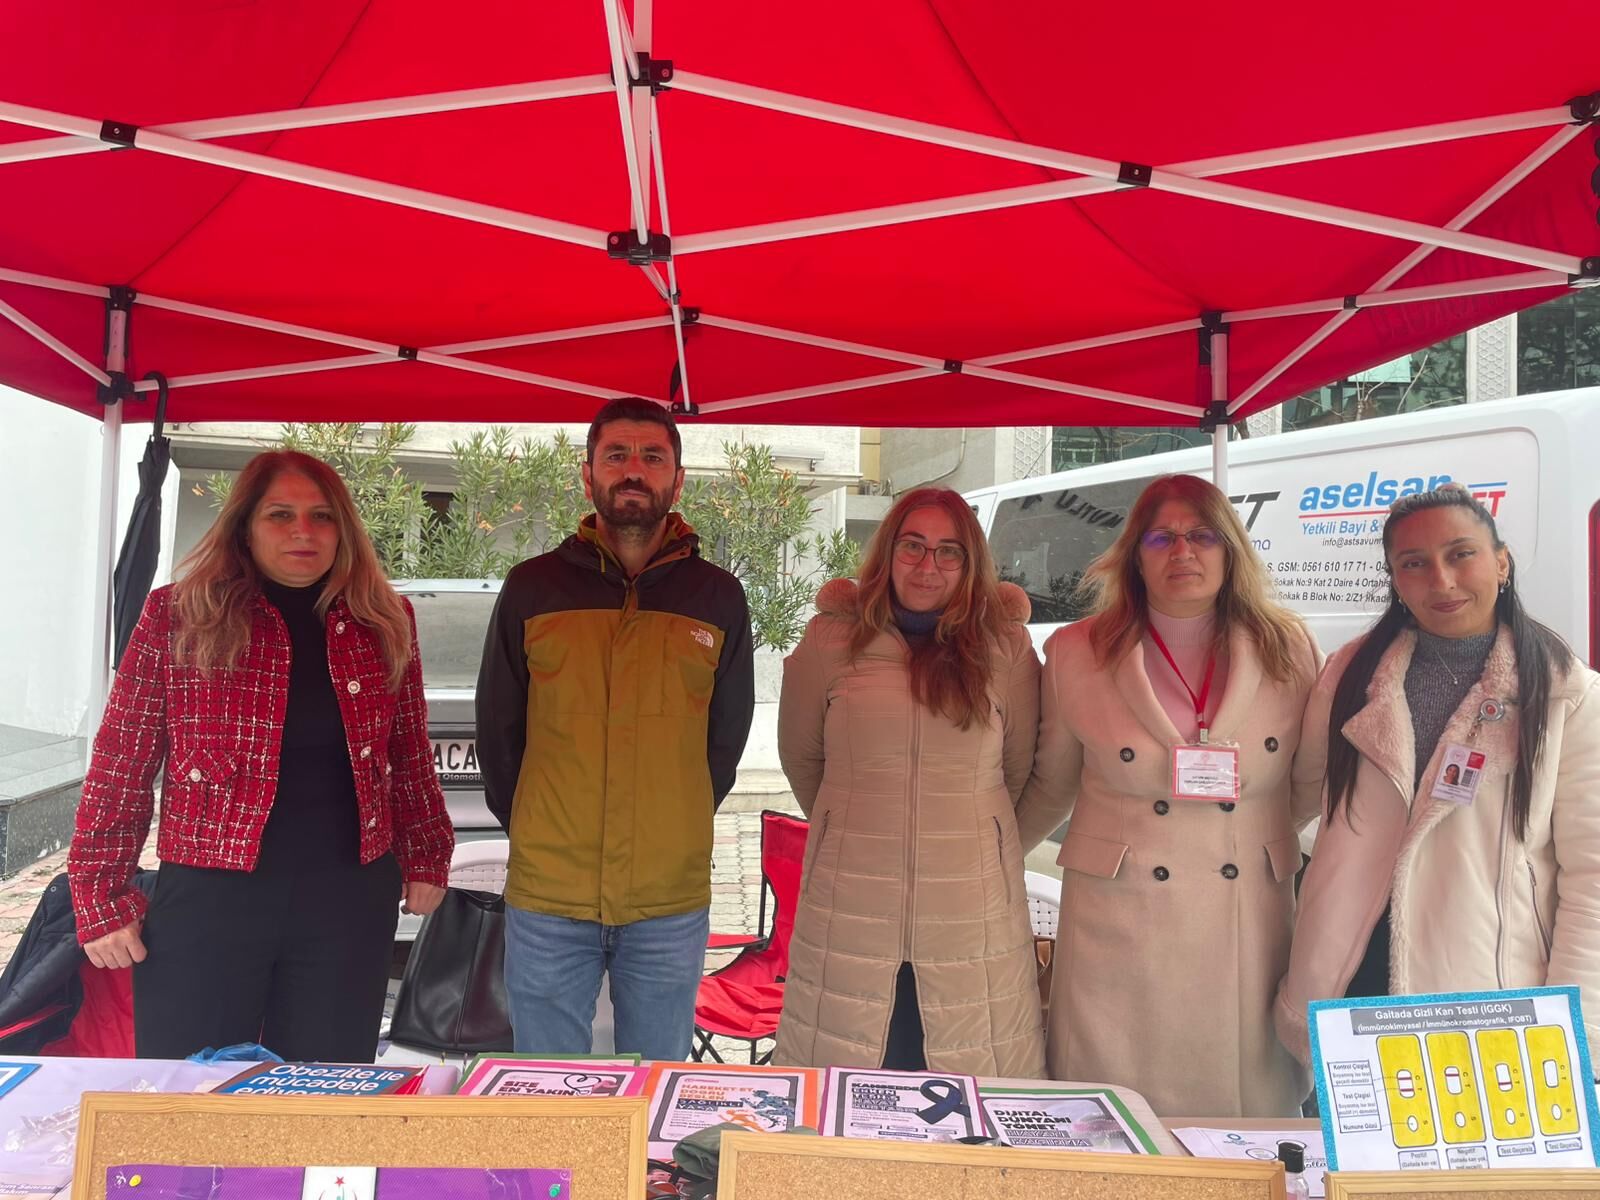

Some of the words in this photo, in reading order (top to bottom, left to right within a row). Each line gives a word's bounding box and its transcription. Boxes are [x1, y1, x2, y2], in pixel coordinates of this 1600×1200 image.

[1302, 521, 1337, 535] Yetkili
[1339, 520, 1366, 536] Bayi
[1370, 519, 1379, 533] &
[1277, 561, 1300, 572] GSM:
[1302, 561, 1321, 572] 0561
[1324, 561, 1340, 572] 610
[1343, 561, 1354, 572] 17
[1356, 561, 1367, 572] 71
[1274, 578, 1294, 587] Sokak
[1295, 578, 1312, 587] No:9
[1313, 578, 1326, 587] Kat
[1327, 579, 1332, 587] 2
[1333, 578, 1353, 587] Daire
[1354, 579, 1360, 587] 4
[1279, 592, 1300, 601] Sokak
[1302, 592, 1308, 601] B
[1310, 592, 1327, 601] Blok
[1329, 592, 1344, 602] No:
[1375, 1009, 1412, 1020] Gaitada
[1413, 1008, 1433, 1018] Gizli
[1435, 1007, 1454, 1016] Kan
[1456, 1006, 1478, 1016] Testi
[1480, 1003, 1513, 1015] (İGGK)
[269, 1065, 376, 1080] Obezite
[376, 1070, 405, 1081] ile
[249, 1075, 379, 1092] mücadele
[525, 1088, 575, 1096] YAKIN
